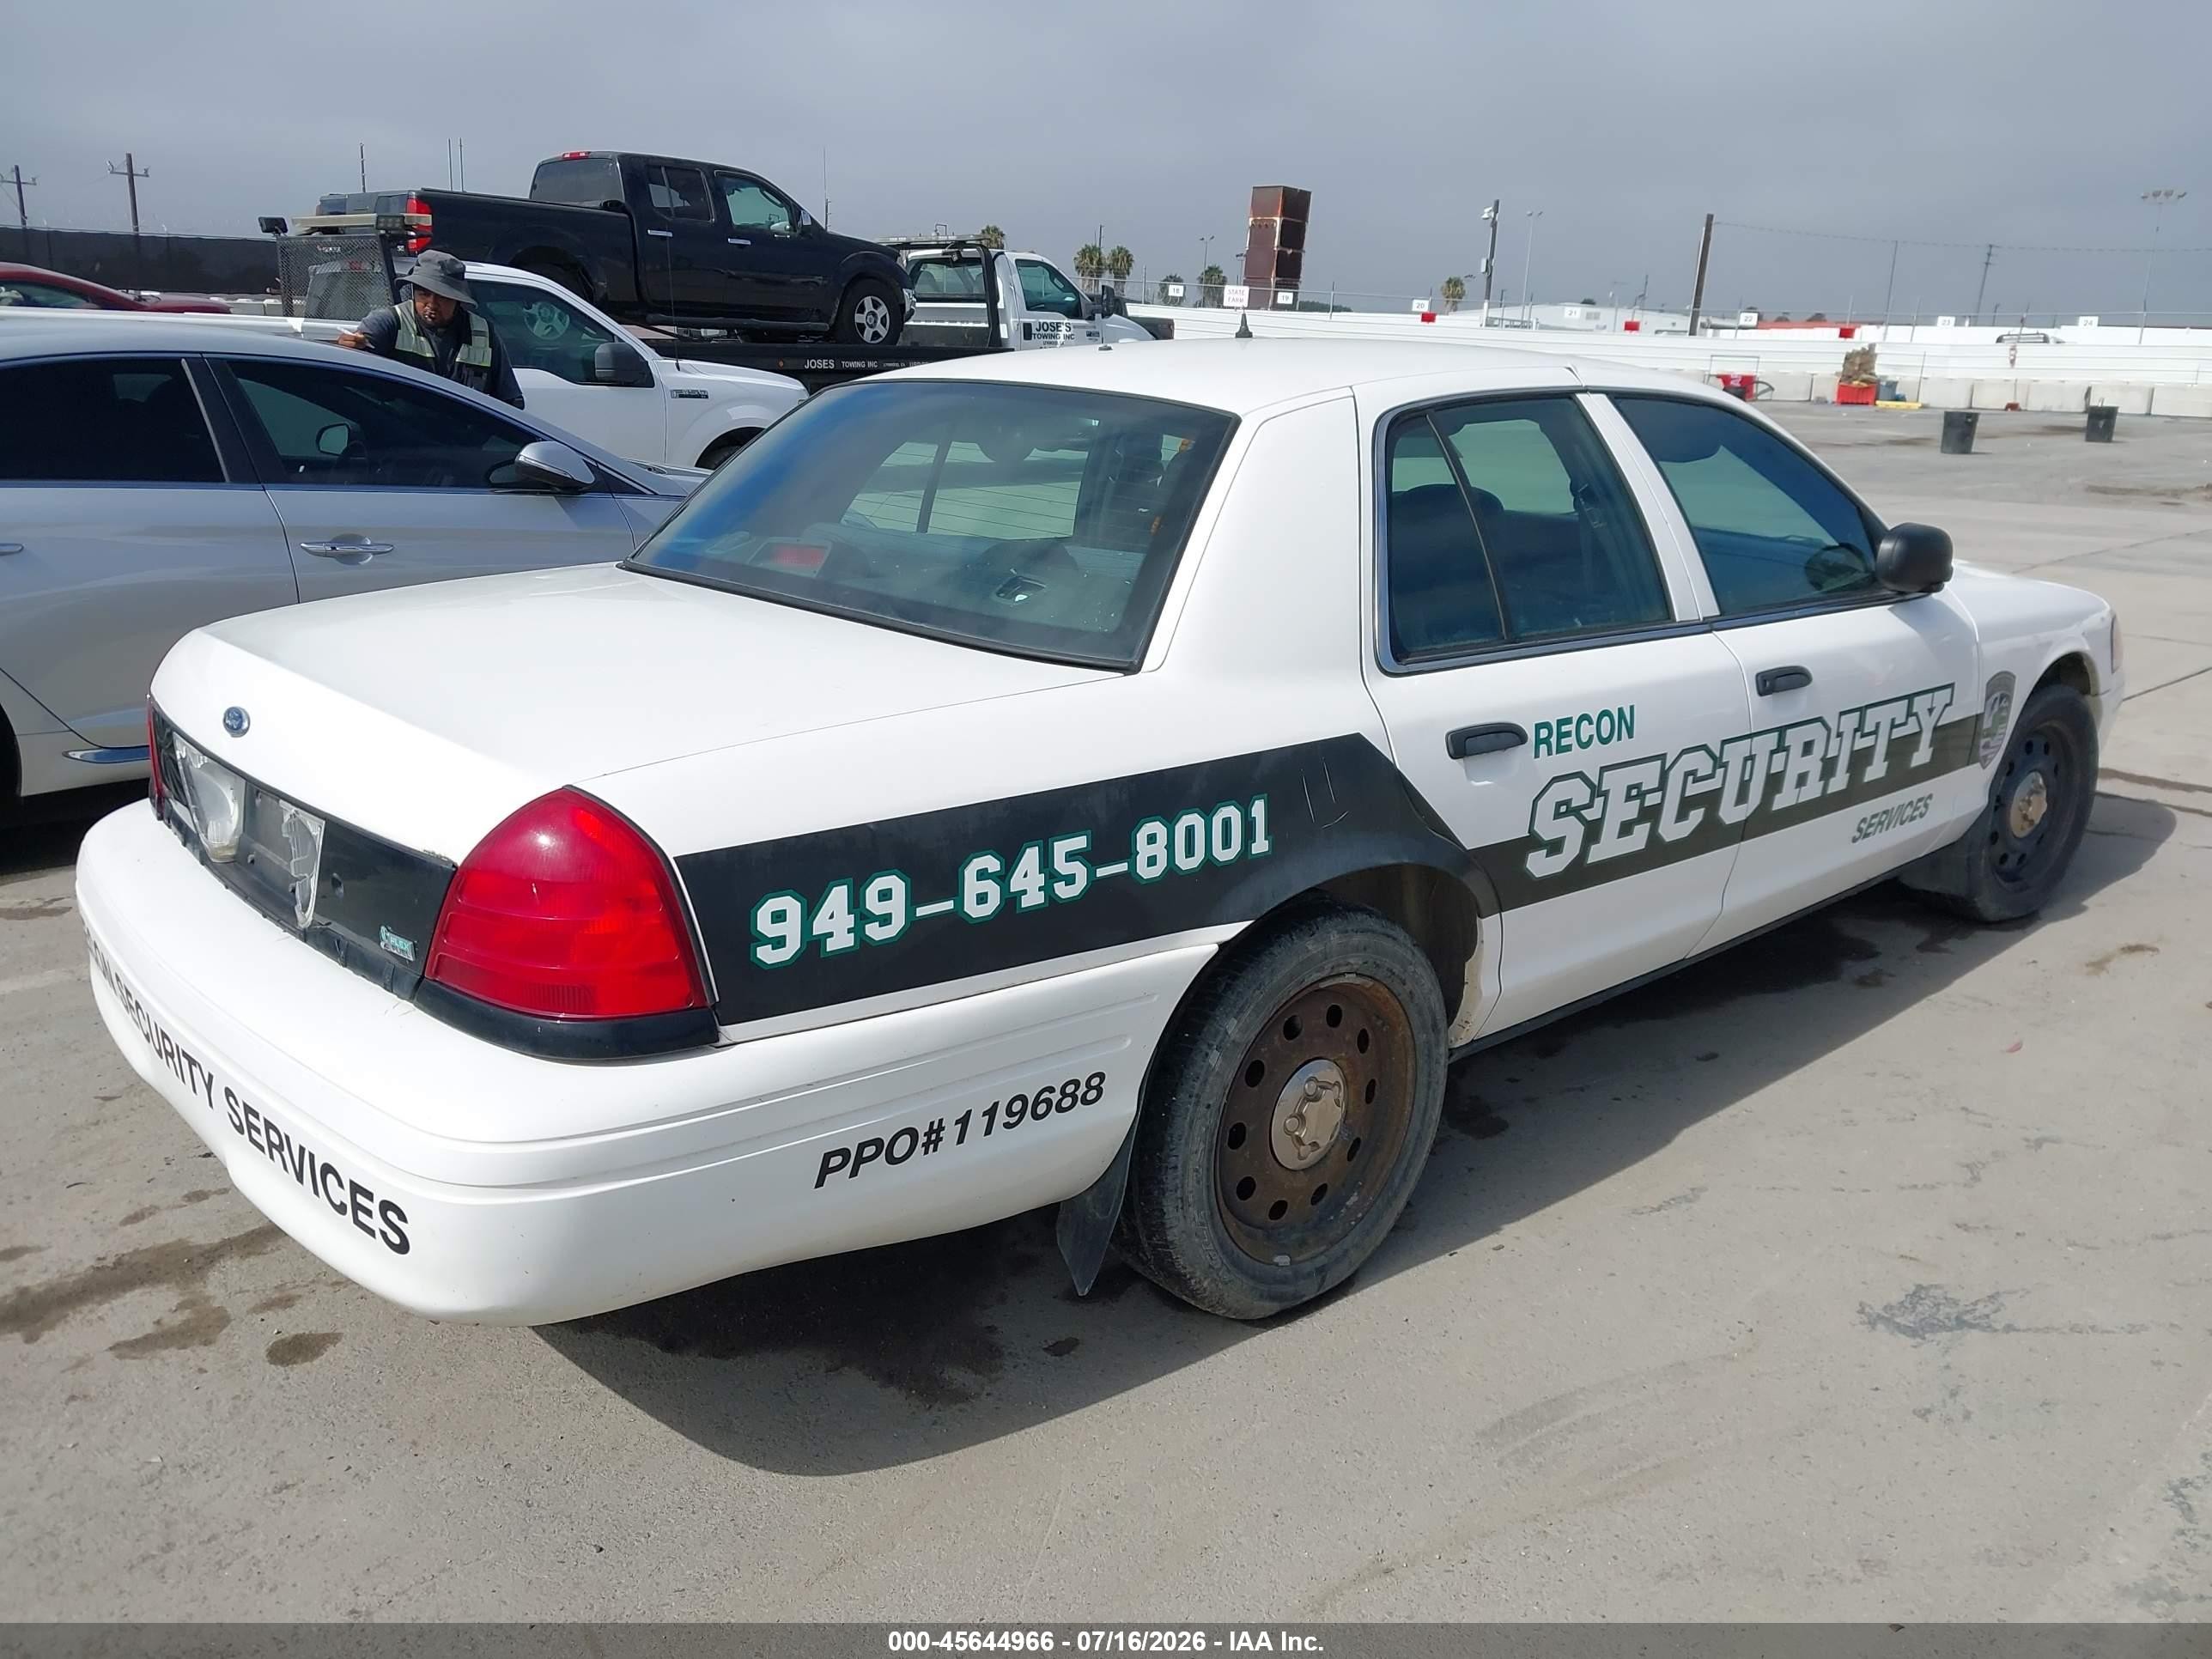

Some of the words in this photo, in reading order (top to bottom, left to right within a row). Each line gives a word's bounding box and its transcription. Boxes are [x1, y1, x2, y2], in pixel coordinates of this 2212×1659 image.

[805, 359, 835, 369] JOSES
[1036, 321, 1072, 332] JOSE'S
[1533, 705, 1636, 758] RECON
[1525, 683, 1955, 879] SECURITY
[1851, 793, 1934, 844] SERVICES
[750, 793, 1272, 969] 949-645-8001
[114, 971, 214, 1109] SECURITY
[223, 1085, 410, 1255] SERVICES
[813, 1072, 1106, 1189] PPO#119688
